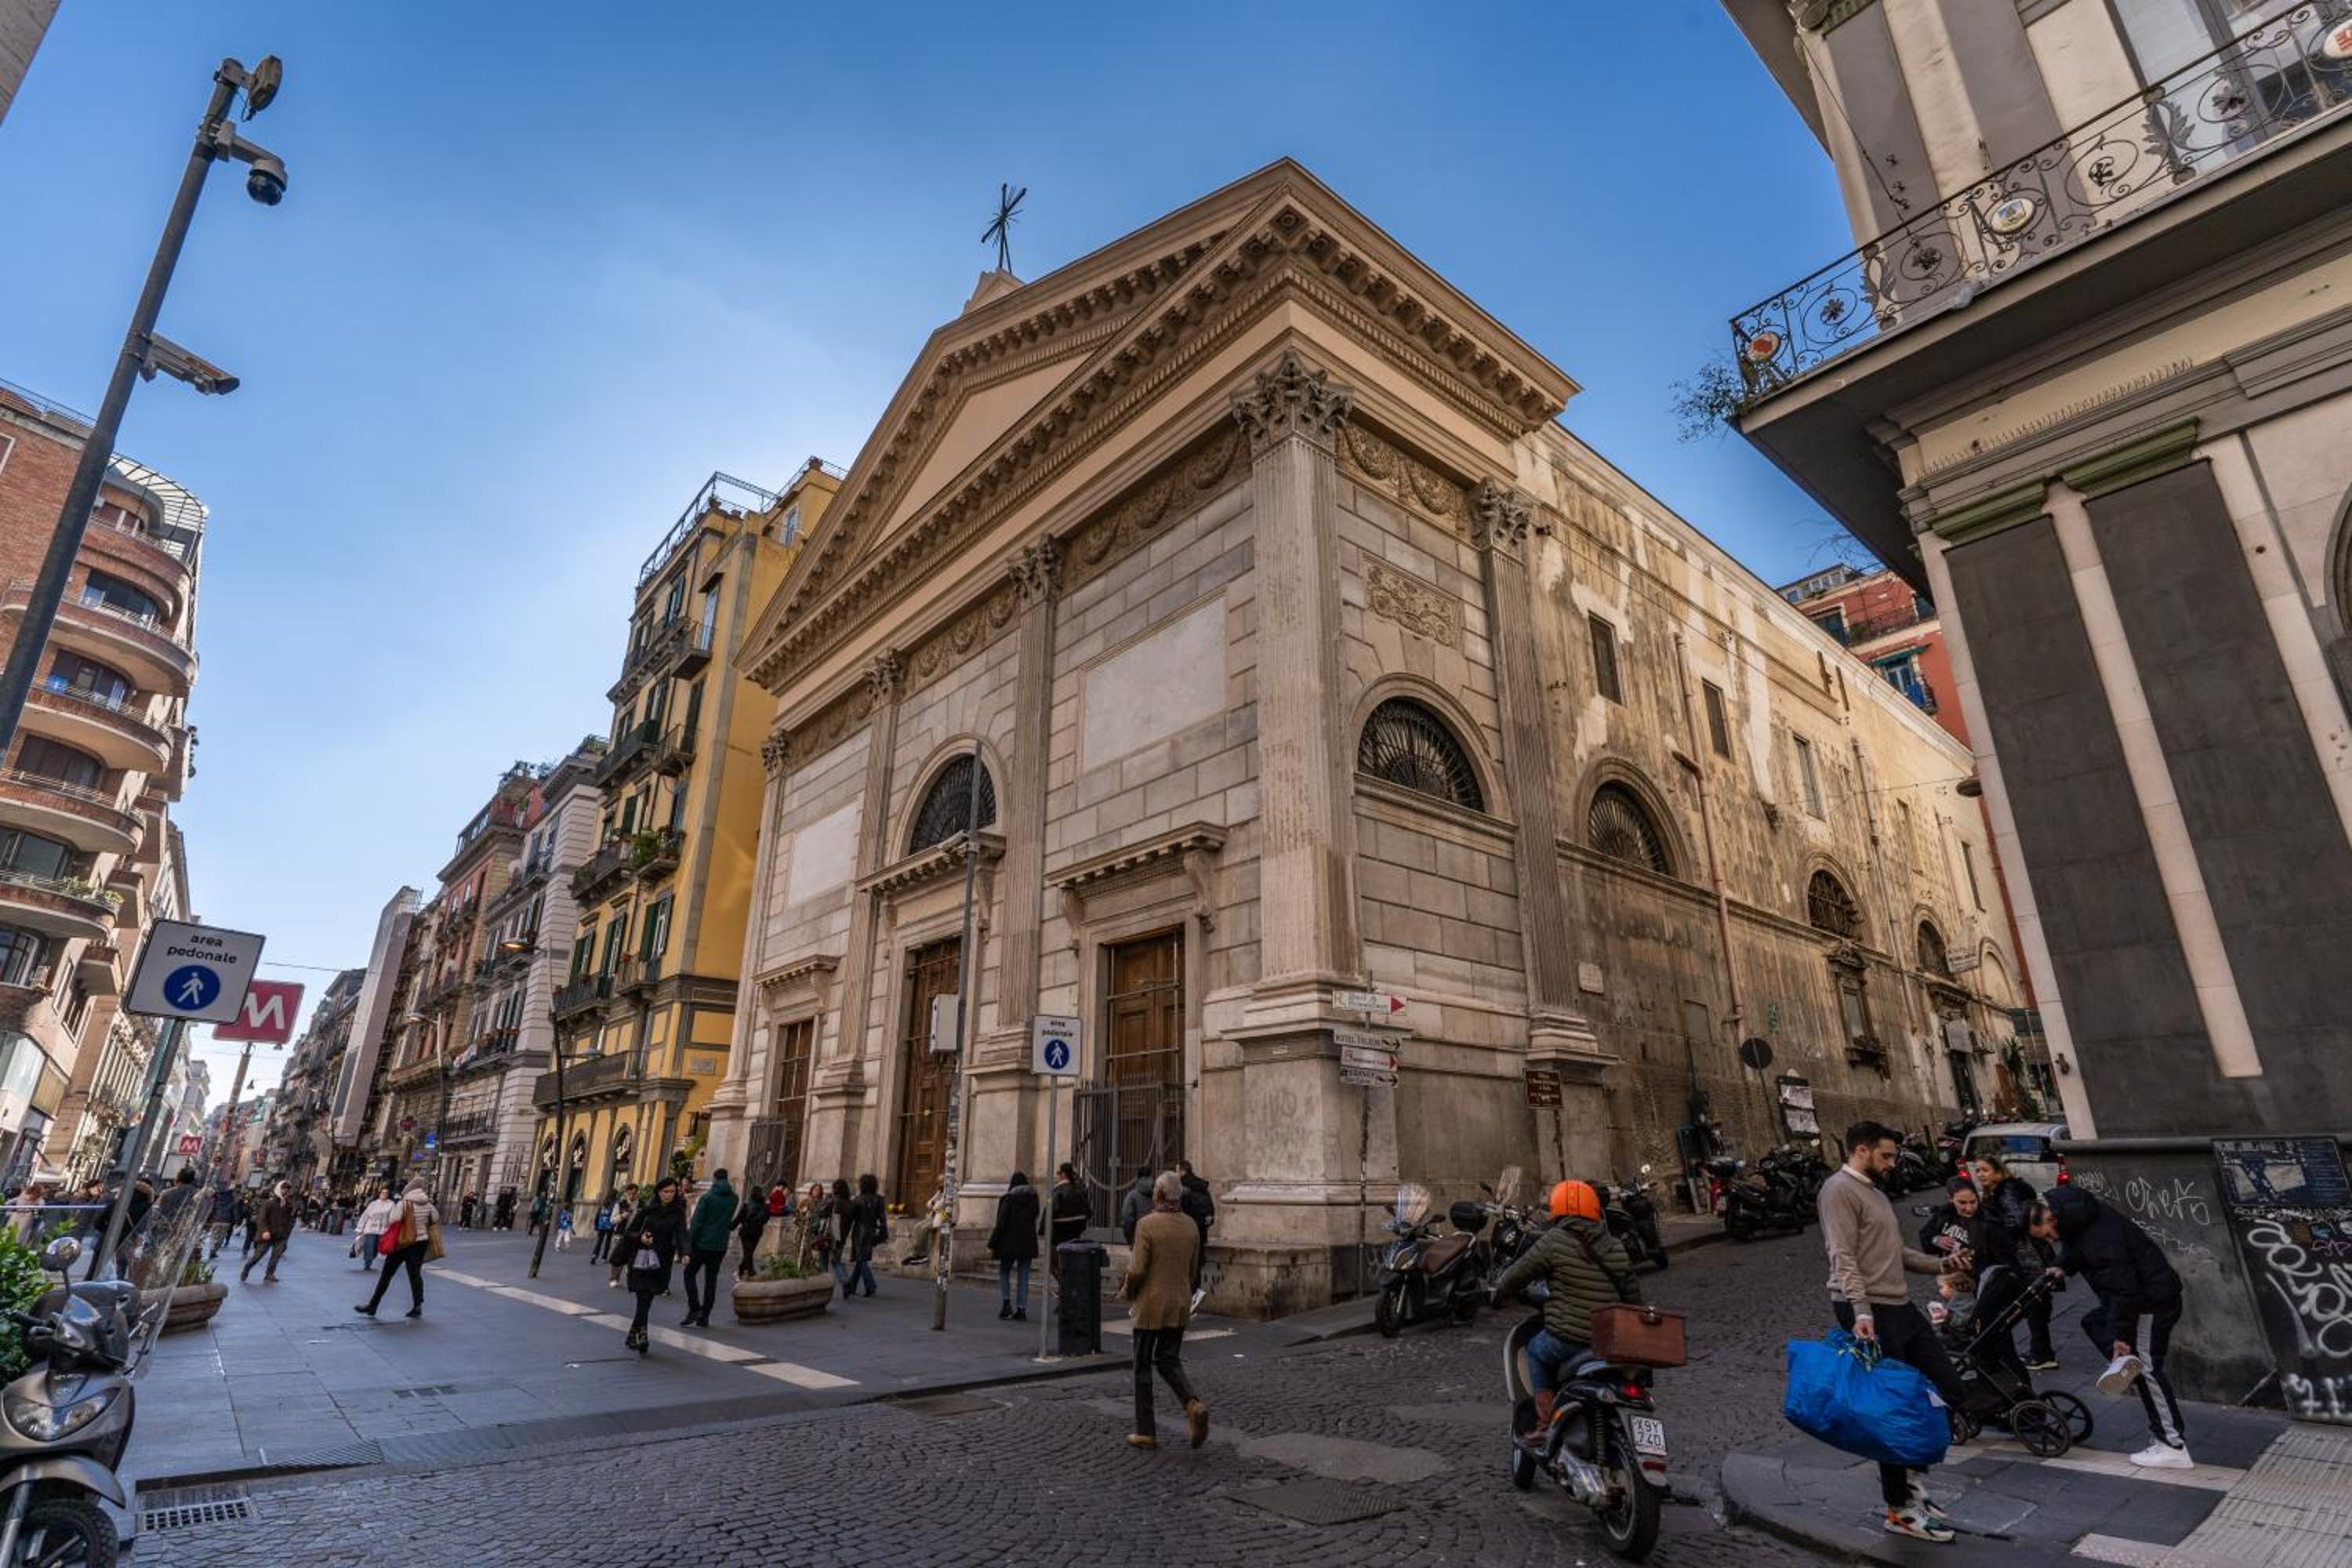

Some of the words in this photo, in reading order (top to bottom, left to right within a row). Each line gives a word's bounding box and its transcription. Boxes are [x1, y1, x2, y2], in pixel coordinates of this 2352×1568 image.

[190, 934, 224, 948] area
[166, 945, 238, 964] pedonale
[244, 992, 285, 1029] M
[181, 1138, 198, 1151] M
